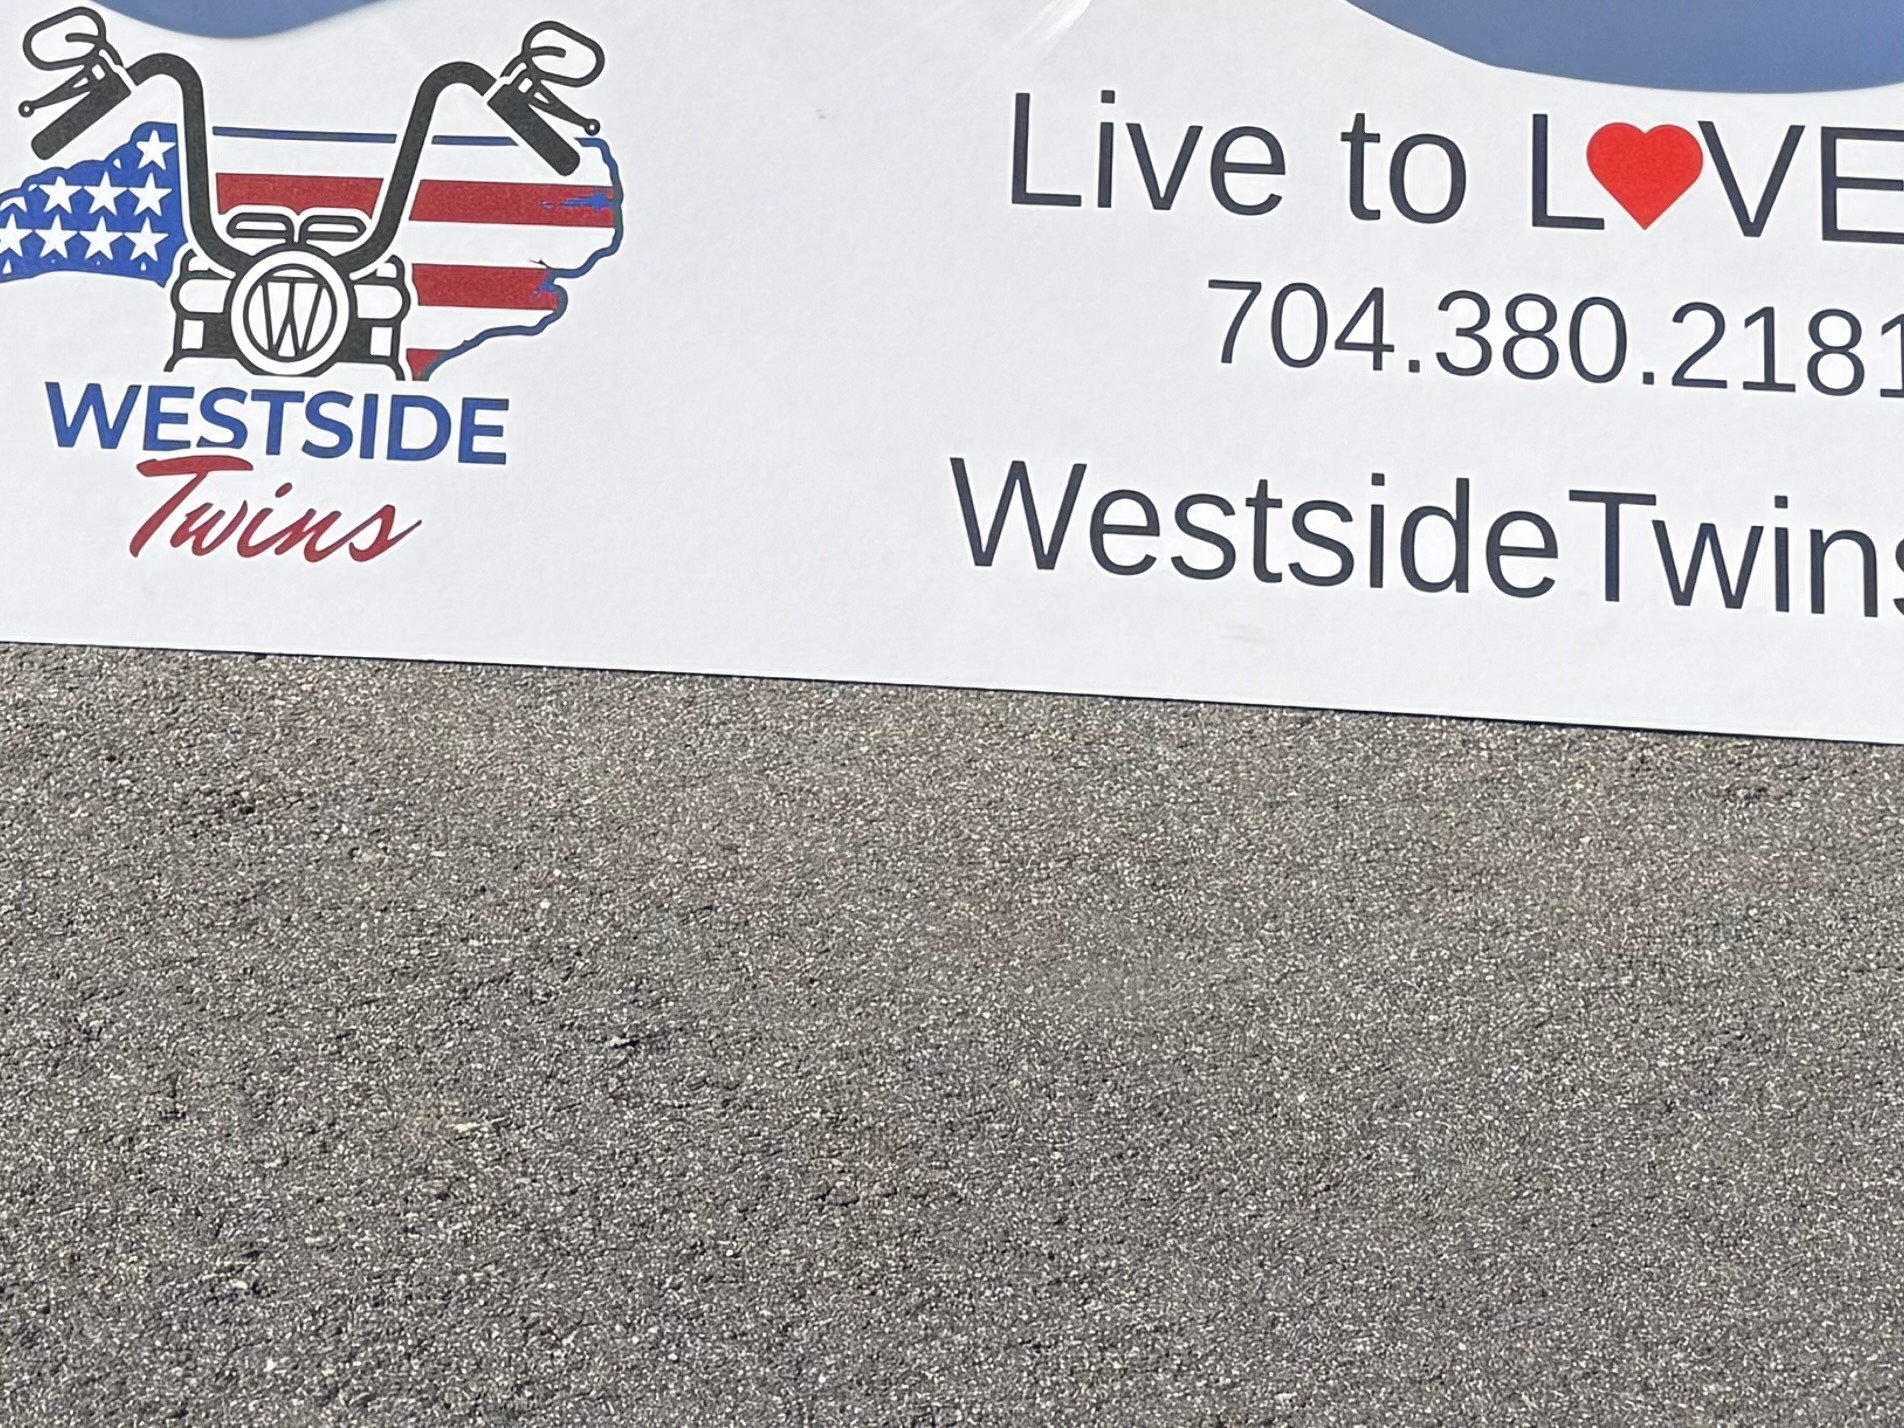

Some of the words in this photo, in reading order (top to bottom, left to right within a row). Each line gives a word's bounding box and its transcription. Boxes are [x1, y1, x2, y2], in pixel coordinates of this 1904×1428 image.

[1010, 89, 1287, 217] Live
[1339, 111, 1468, 225] to
[43, 380, 511, 467] WESTSIDE
[128, 453, 423, 565] Twins
